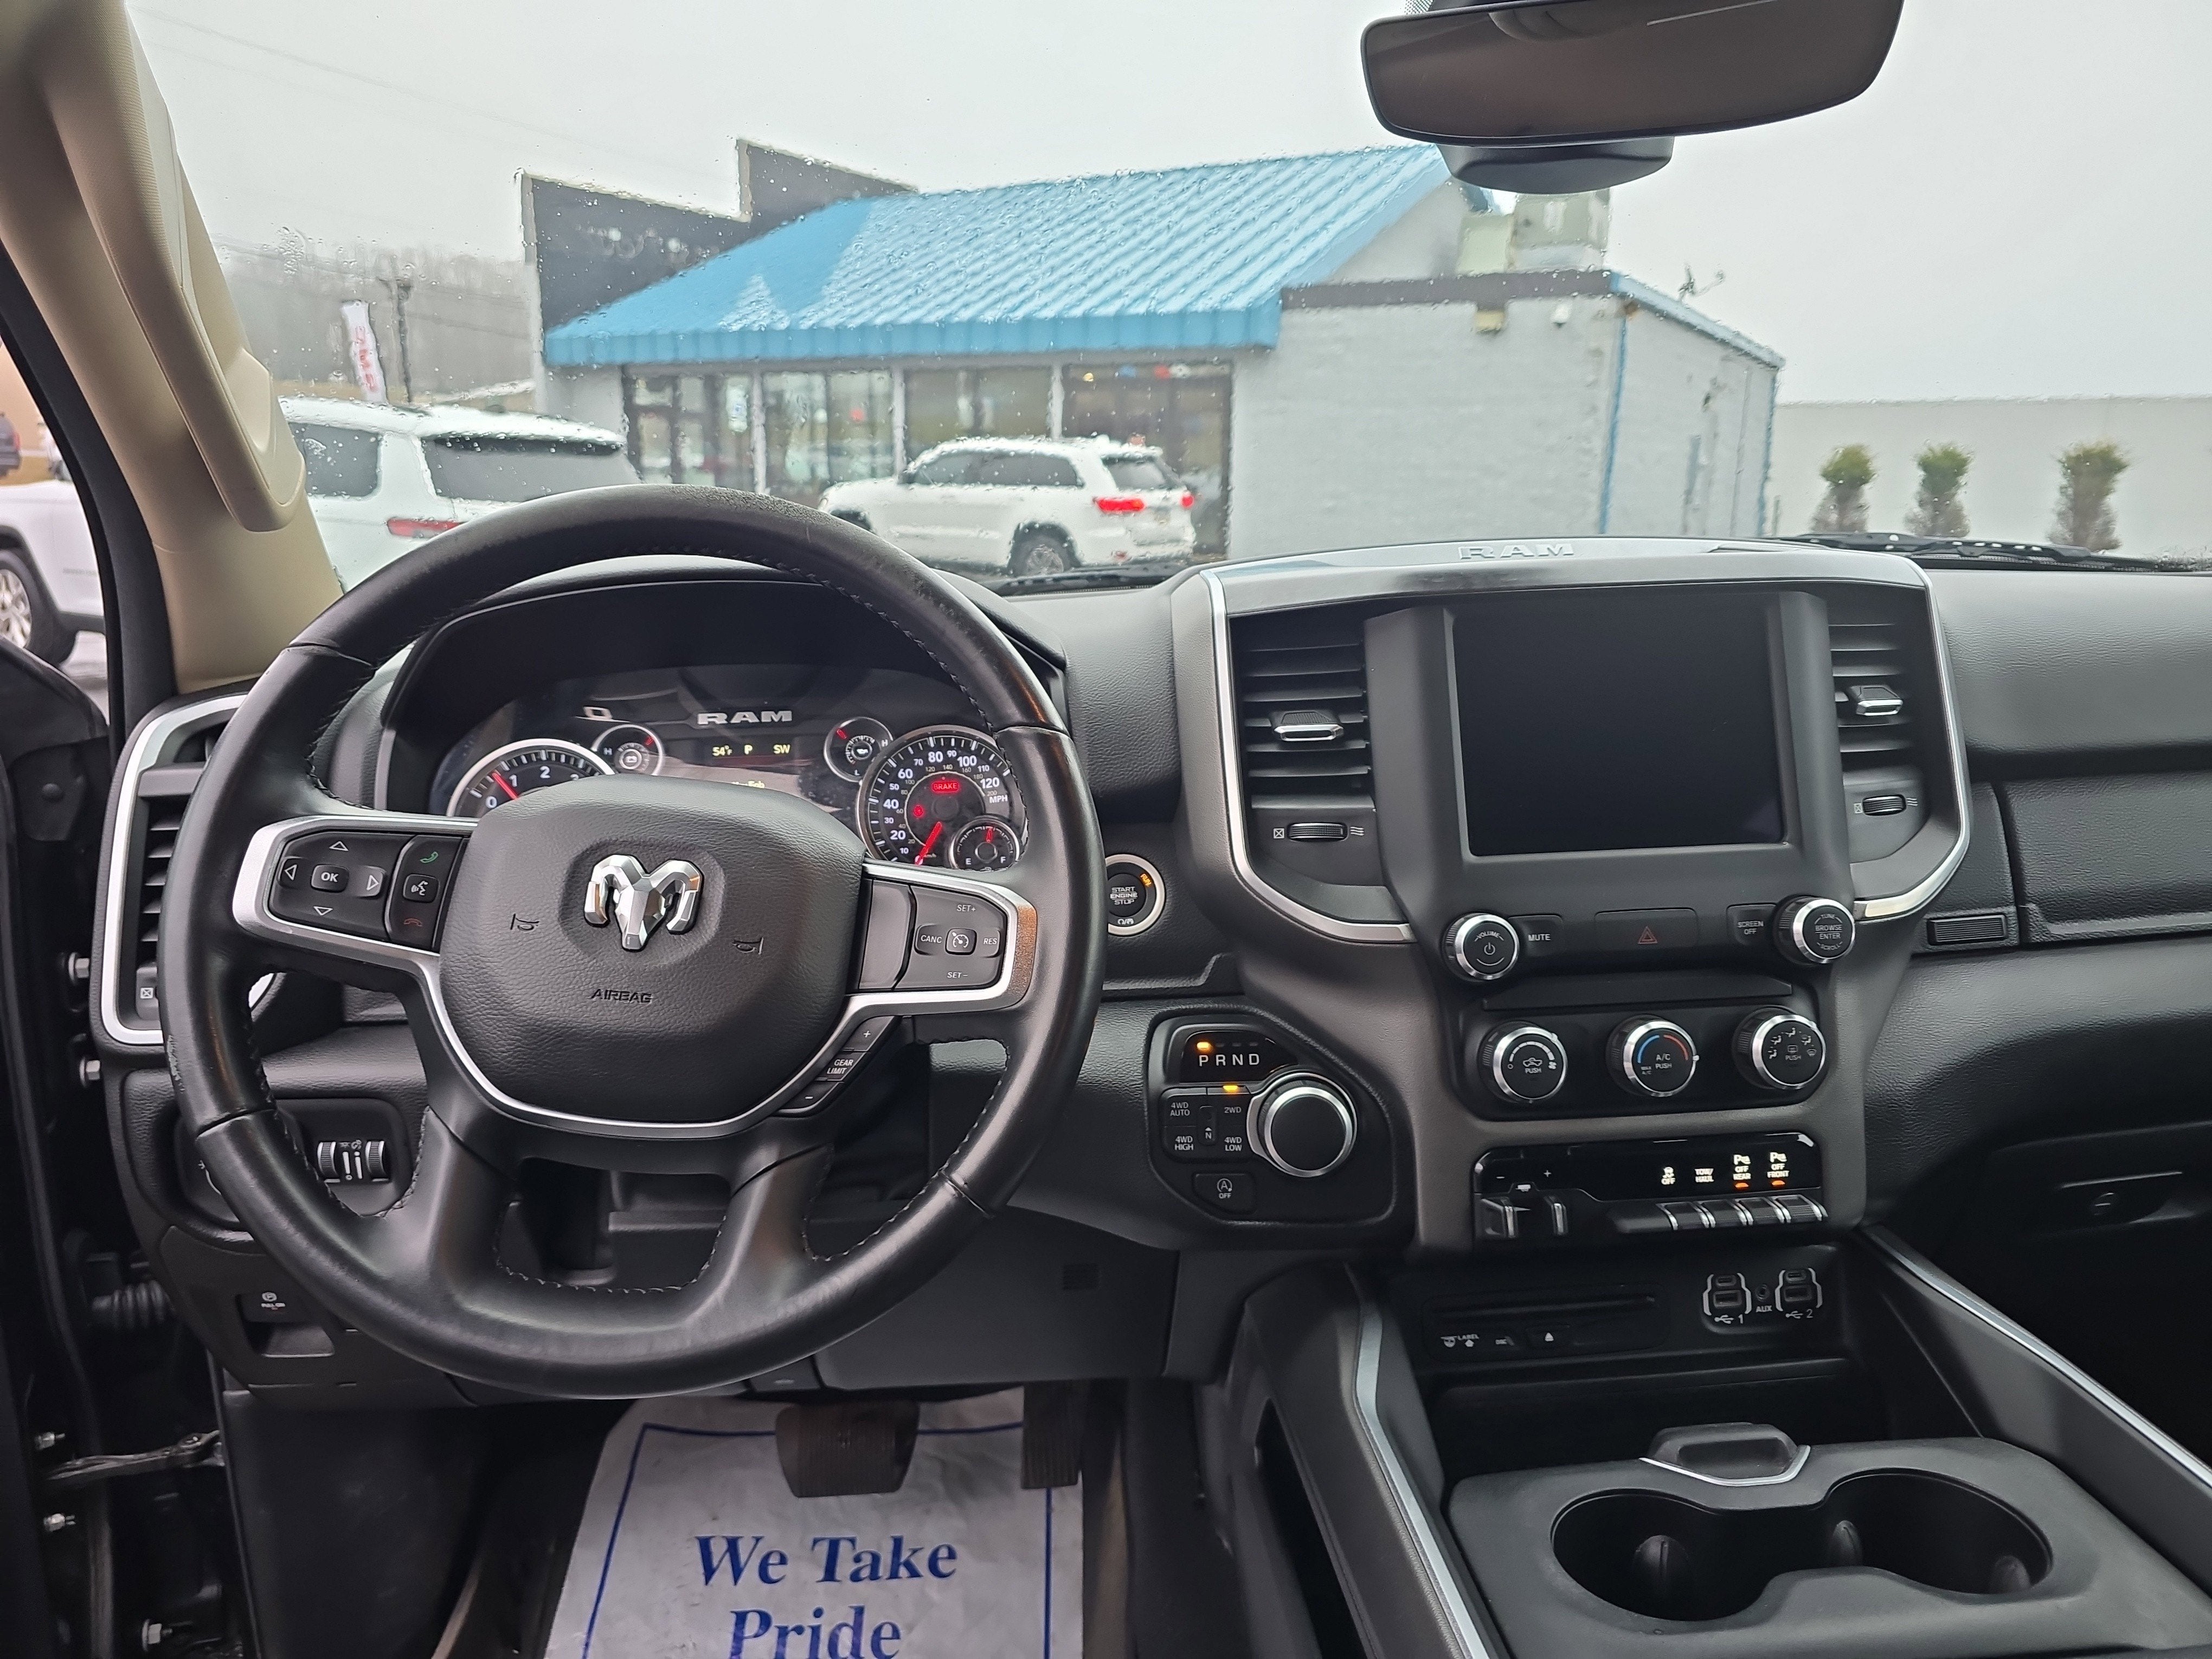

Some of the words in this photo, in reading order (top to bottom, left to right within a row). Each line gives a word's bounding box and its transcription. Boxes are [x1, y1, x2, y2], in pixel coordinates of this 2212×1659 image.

[1458, 543, 1574, 560] RAM
[697, 710, 793, 725] RAM
[744, 744, 753, 755] P
[773, 744, 790, 754] SW
[928, 751, 943, 763] 80
[957, 755, 977, 767] 100
[539, 766, 551, 779] 2
[898, 768, 913, 779] 60
[509, 774, 518, 787] 1
[980, 777, 1000, 788] 120
[486, 797, 498, 808] 0
[883, 799, 899, 809] 40
[989, 795, 1008, 803] MPH
[890, 830, 906, 840] 20
[320, 871, 339, 883] OK
[920, 934, 943, 944] CANC
[1477, 931, 1501, 939] VOLUME
[983, 937, 998, 945] RES
[589, 988, 653, 1004] AIRBAG
[1199, 1054, 1209, 1067] P
[1216, 1054, 1226, 1066] R
[1232, 1053, 1244, 1066] N
[1248, 1053, 1260, 1065] D
[1766, 1170, 1790, 1178] FRONT
[1756, 1305, 1773, 1313] AUX
[1806, 1308, 1814, 1319] 2
[1738, 1314, 1744, 1324] 1
[695, 1535, 788, 1586] We
[811, 1535, 958, 1583] Take
[730, 1604, 901, 1659] Pride
